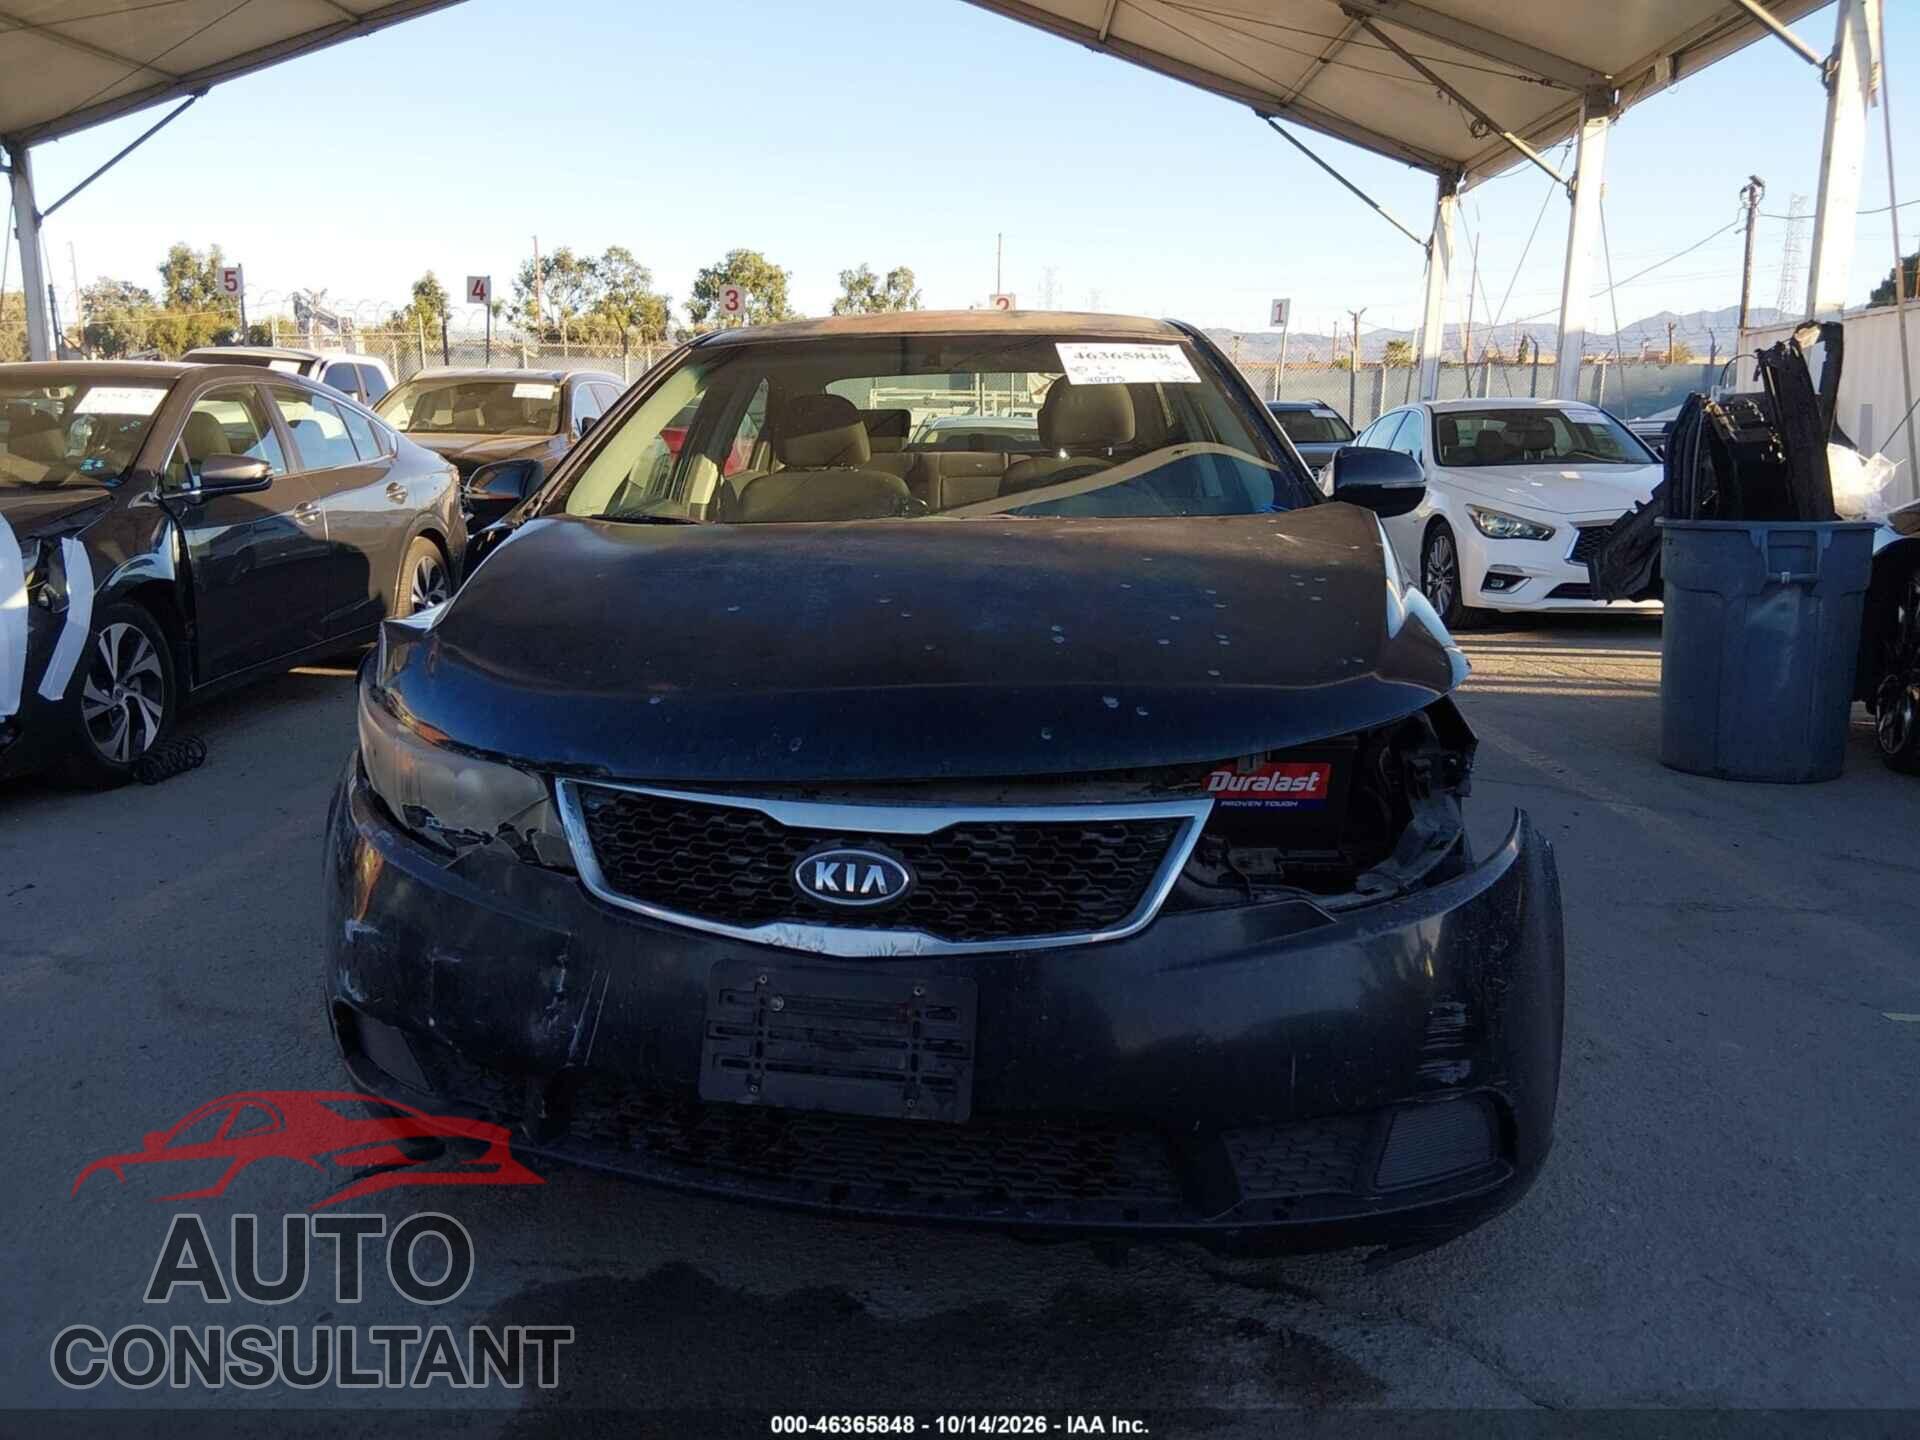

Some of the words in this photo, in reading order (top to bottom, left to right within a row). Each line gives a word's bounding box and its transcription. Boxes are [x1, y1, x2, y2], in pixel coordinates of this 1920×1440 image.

[224, 270, 238, 292] 5
[472, 279, 486, 301] 4
[725, 289, 738, 311] 3
[1275, 302, 1284, 324] 1
[1207, 771, 1321, 792] Duralast
[1220, 800, 1263, 808] PROVEN
[1264, 800, 1299, 808] TOUGH
[815, 861, 888, 895] KIA
